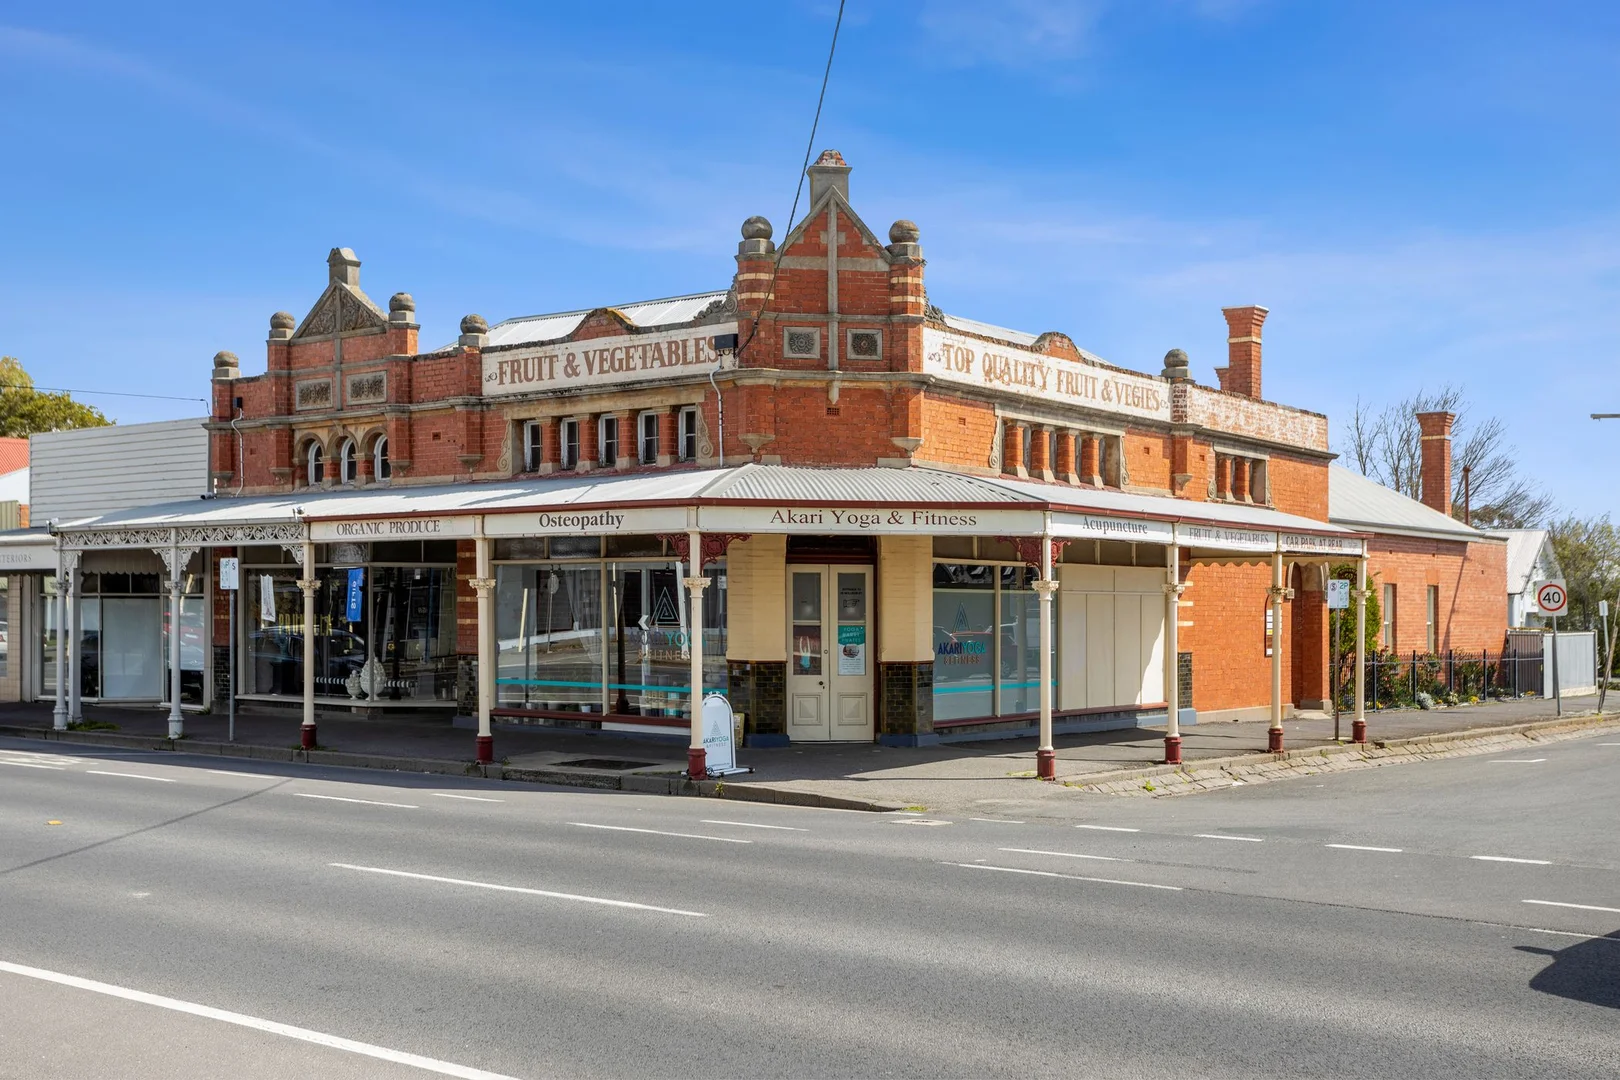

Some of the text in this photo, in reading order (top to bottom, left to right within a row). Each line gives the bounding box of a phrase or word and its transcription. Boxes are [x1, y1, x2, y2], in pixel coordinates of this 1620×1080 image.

[497, 335, 720, 386] FRUIT & VEGETABLES
[942, 343, 1161, 413] TOP QUALITY FRUIT & VEGIES
[336, 519, 441, 536] ORGANIC PRODUCE
[539, 510, 625, 531] Osteopathy
[770, 509, 977, 528] Akari Yoga & Fitness
[1082, 515, 1148, 535] Acupuncture
[1189, 527, 1270, 545] FRUIT & VEGETABLES
[1285, 536, 1299, 548] CAR
[1301, 537, 1316, 549] PARK
[1319, 538, 1327, 550] AT
[1340, 582, 1348, 590] 2P
[1542, 591, 1561, 604] 40
